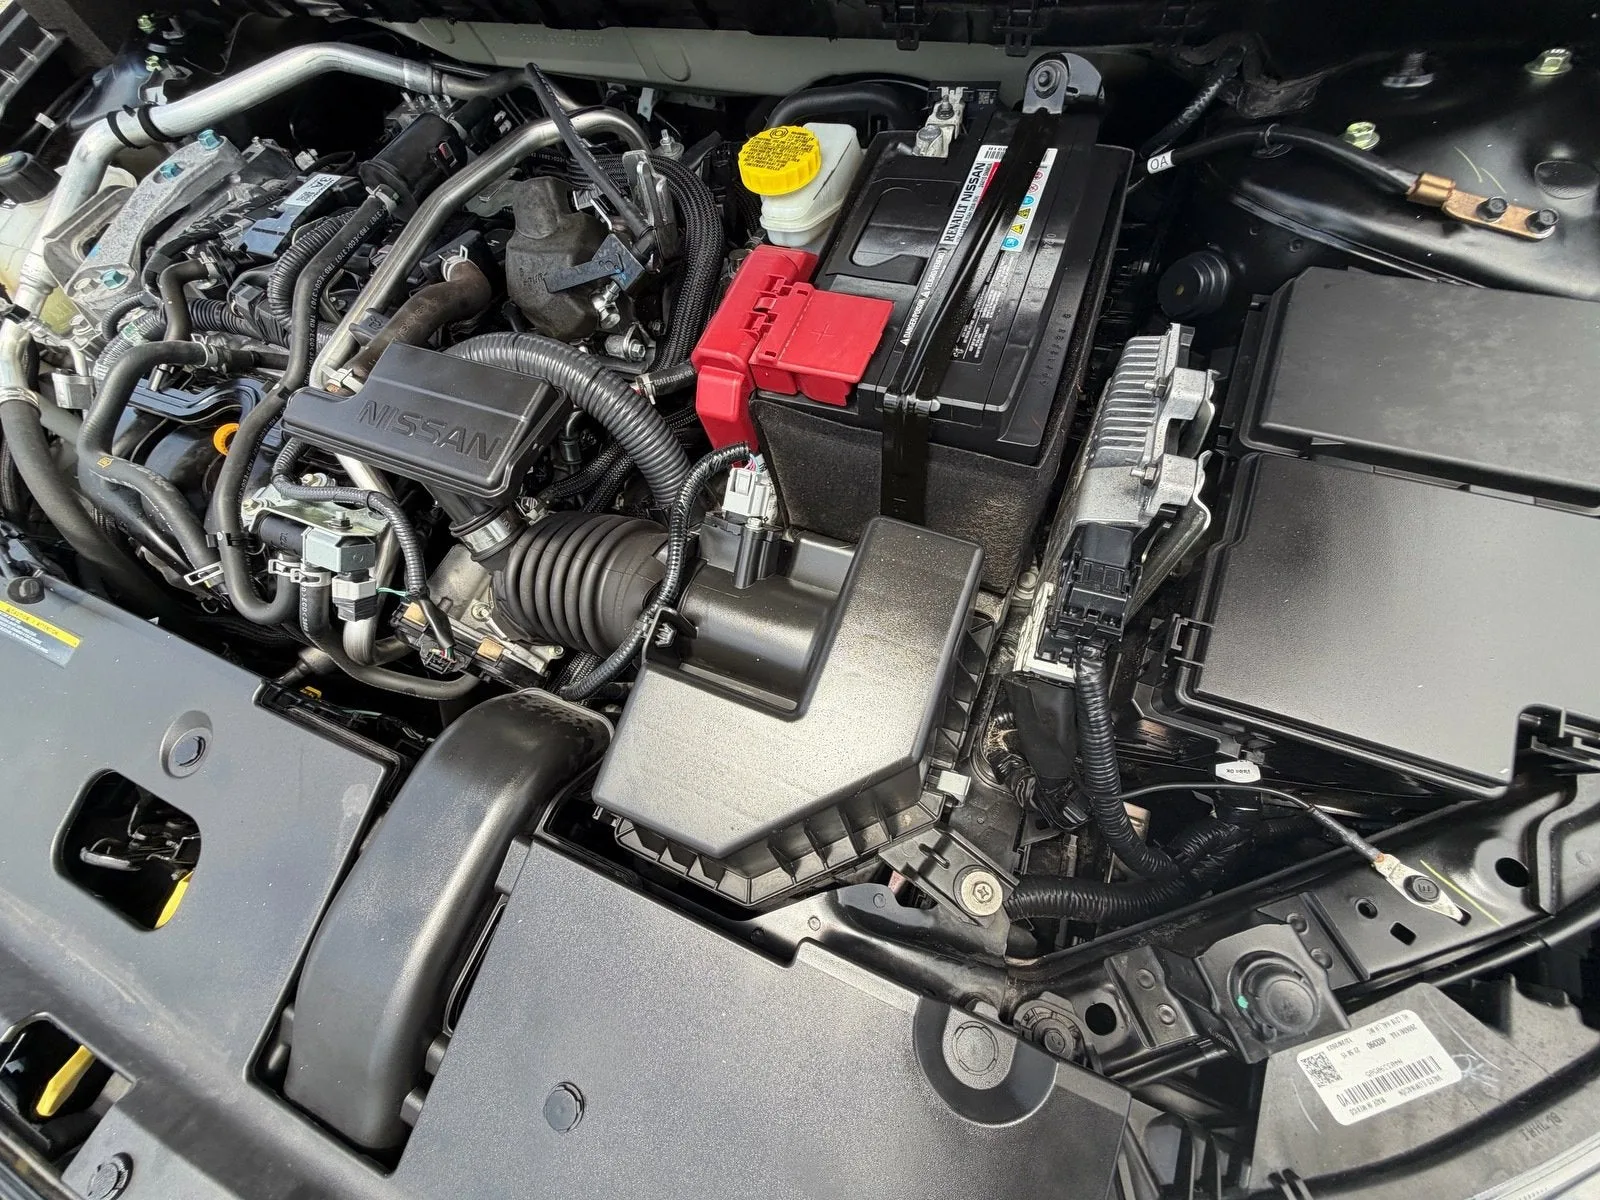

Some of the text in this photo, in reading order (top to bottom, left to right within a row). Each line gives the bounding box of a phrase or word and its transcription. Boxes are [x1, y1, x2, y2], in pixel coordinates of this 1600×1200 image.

[944, 204, 968, 243] RENAULT
[961, 162, 986, 202] NISSAN
[356, 399, 503, 463] NISSAN
